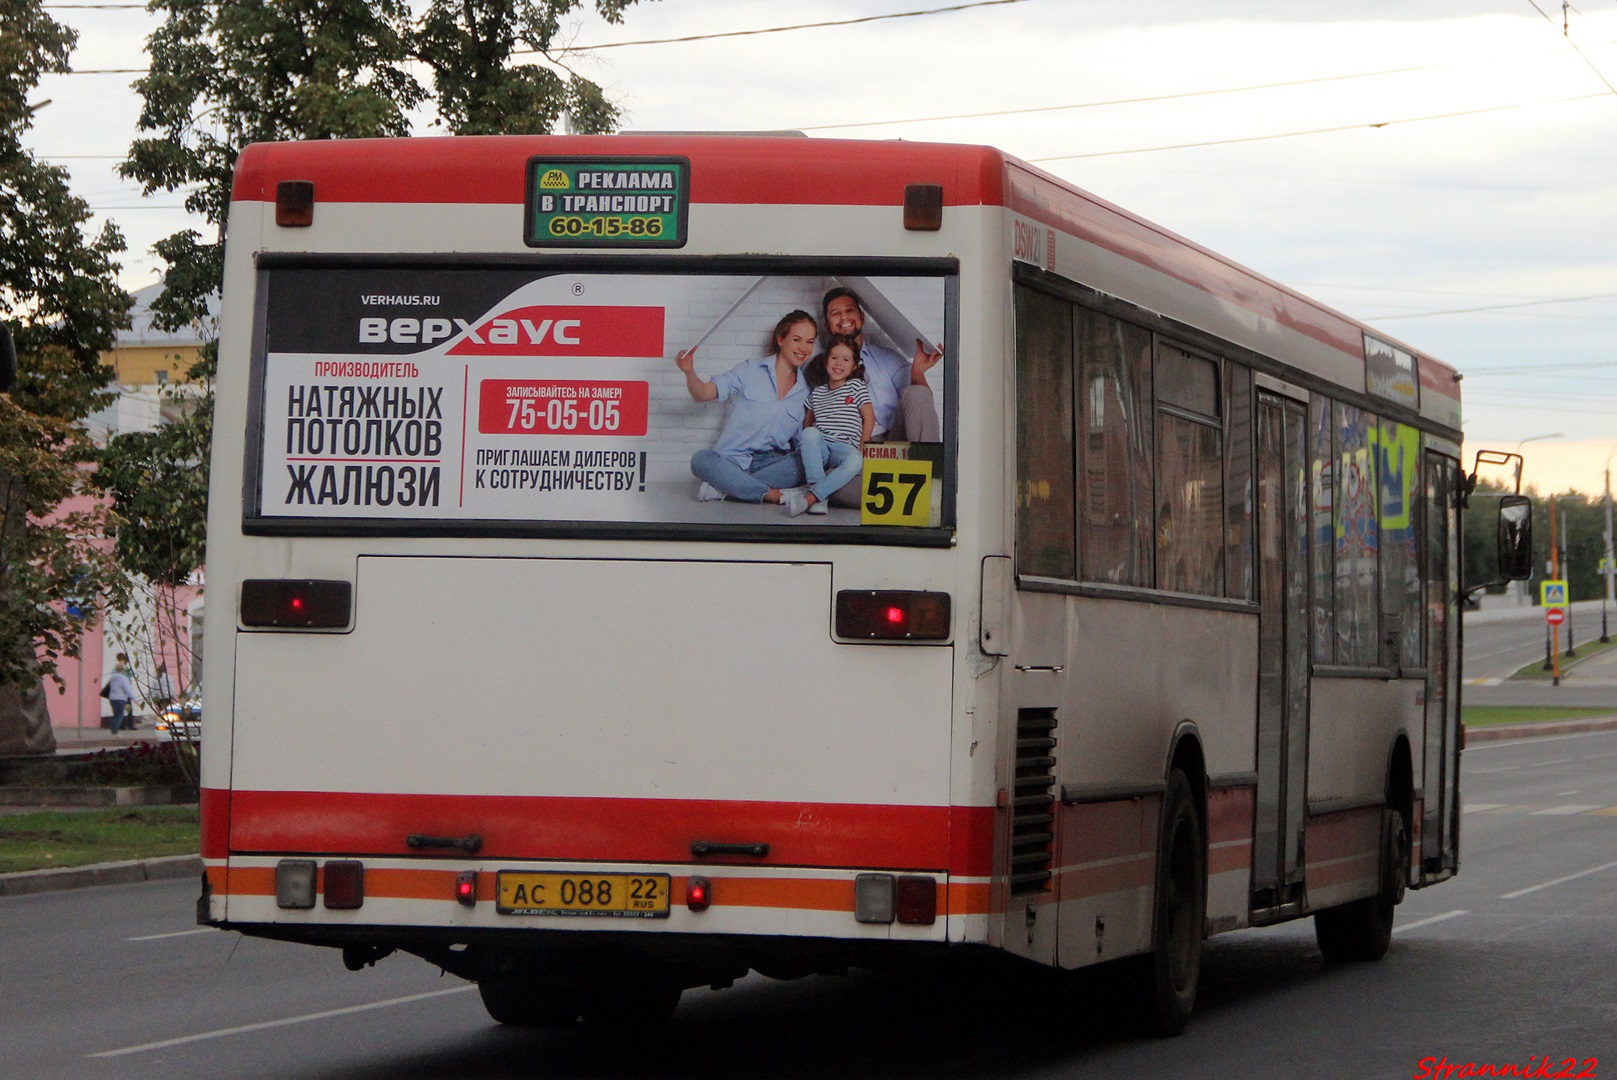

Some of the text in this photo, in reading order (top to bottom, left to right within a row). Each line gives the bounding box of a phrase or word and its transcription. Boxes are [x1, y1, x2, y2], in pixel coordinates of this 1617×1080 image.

[578, 172, 673, 189] РЕКЛАМА
[541, 195, 672, 212] В ТРАНСПОРТ
[550, 217, 663, 236] 60-15-86
[361, 294, 441, 306] VERHAUS.RU
[315, 361, 419, 378] ПРОИЗВОДИТЕЛЬ
[288, 385, 444, 420] НАТЯЖНЫХ
[506, 386, 622, 399] ЗАПИСЫВАЙТЕСЬ НА ЗАМЕР!
[506, 399, 620, 431] 75-05-05
[286, 418, 442, 456] ПОТОЛКОВ
[476, 449, 636, 469] ПРИГЛАШАЕМ ДИЛЕРОВ
[285, 465, 440, 507] ЖАЛЮЗИ
[475, 469, 486, 489] К
[865, 472, 927, 516] 57
[560, 879, 612, 905] 088
[630, 878, 657, 899] 22
[633, 900, 654, 909] RUS
